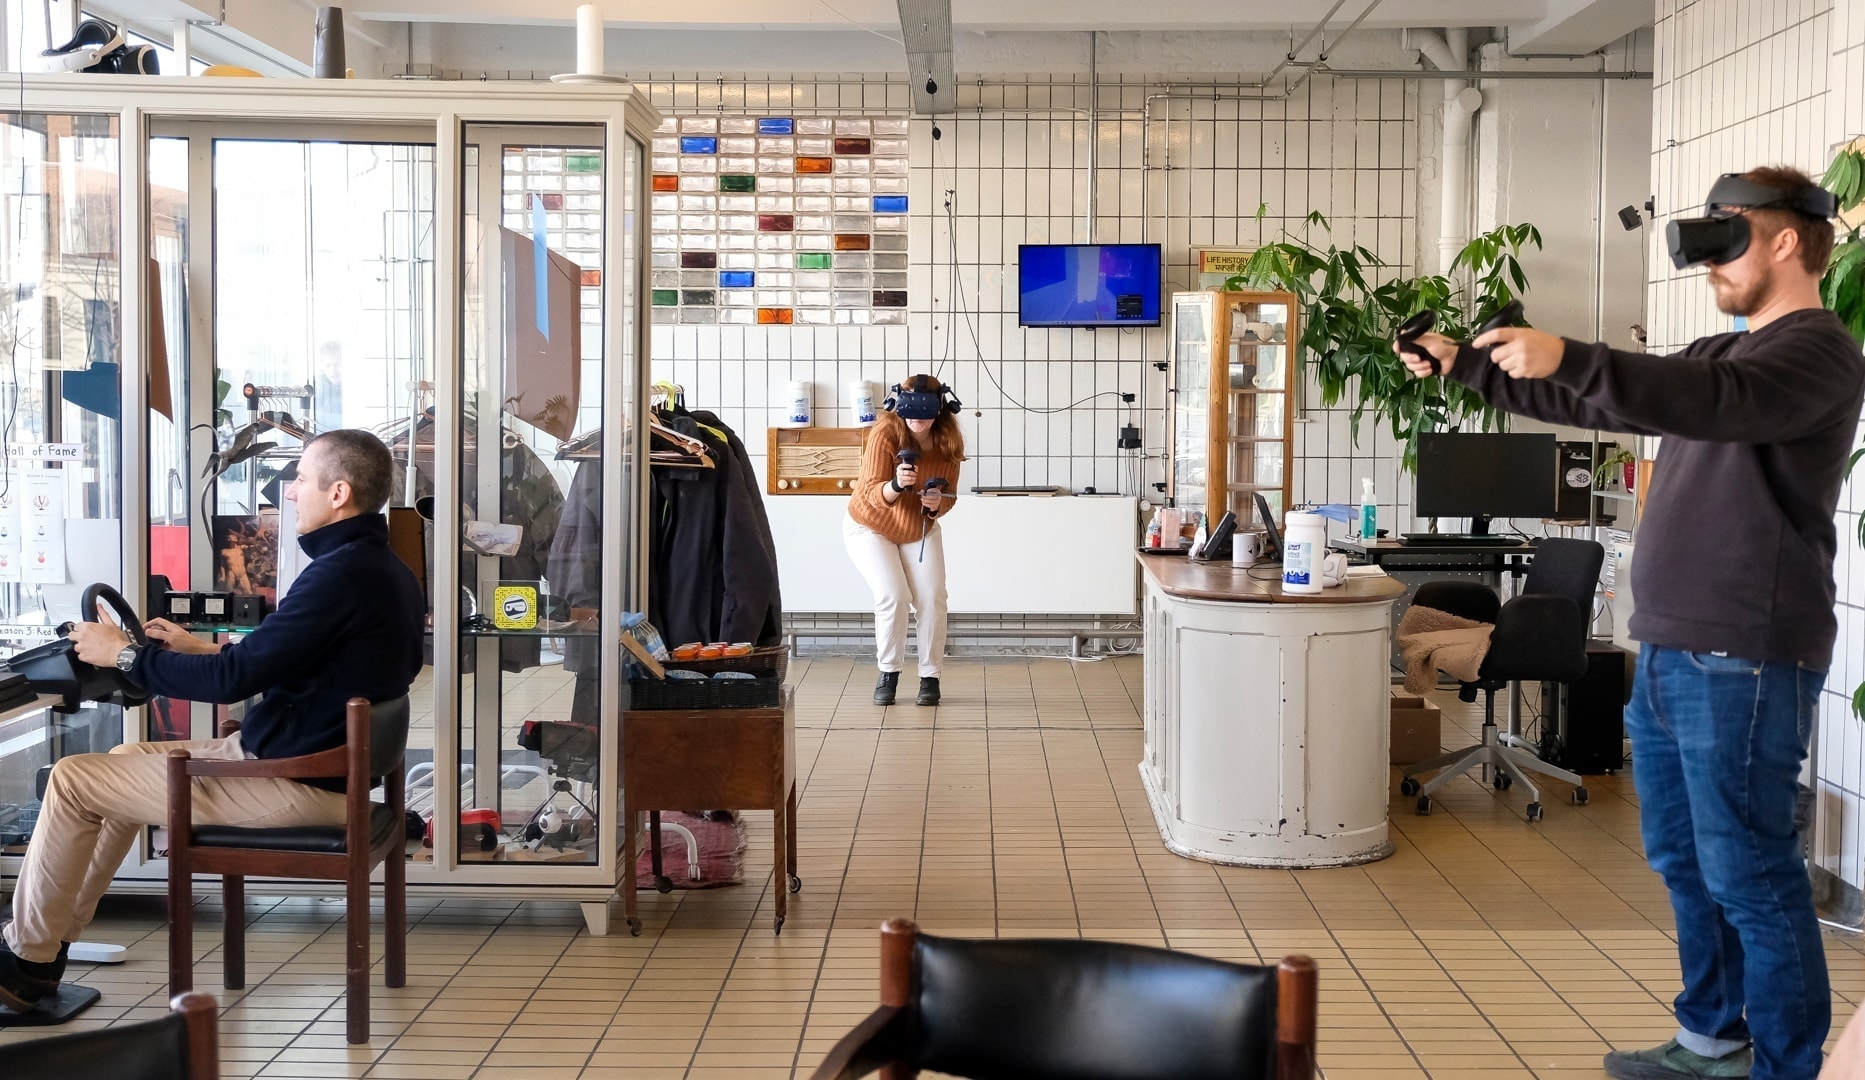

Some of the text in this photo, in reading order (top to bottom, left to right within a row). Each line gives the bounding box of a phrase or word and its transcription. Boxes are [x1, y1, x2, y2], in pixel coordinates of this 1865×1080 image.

[5, 444, 77, 456] Hall of Fame
[26, 627, 35, 636] 3:
[37, 627, 52, 636] Red
